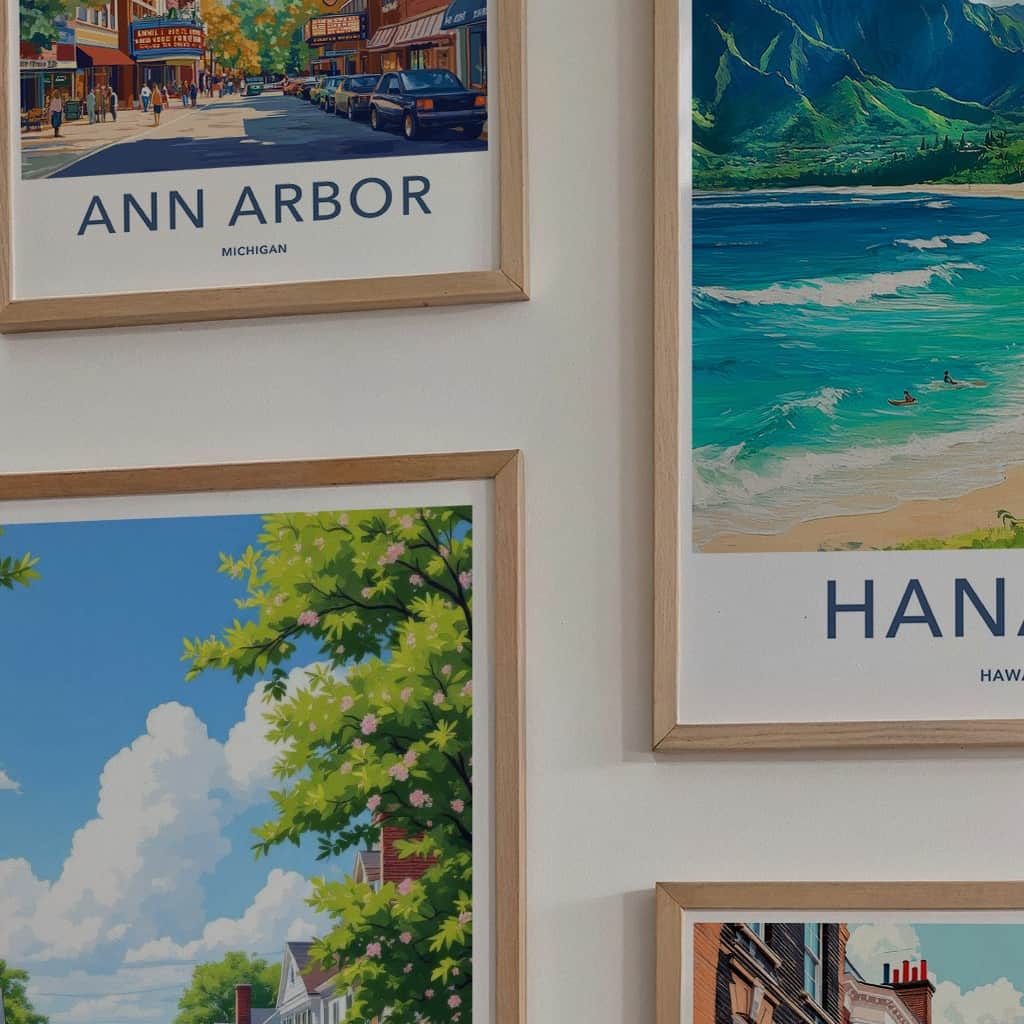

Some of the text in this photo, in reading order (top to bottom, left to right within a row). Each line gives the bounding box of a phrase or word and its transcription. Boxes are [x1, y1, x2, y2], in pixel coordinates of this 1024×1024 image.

[77, 175, 432, 236] ANN ARBOR
[221, 243, 287, 257] MICHIGAN
[826, 577, 1024, 639] HAN
[980, 668, 1024, 682] HAW
